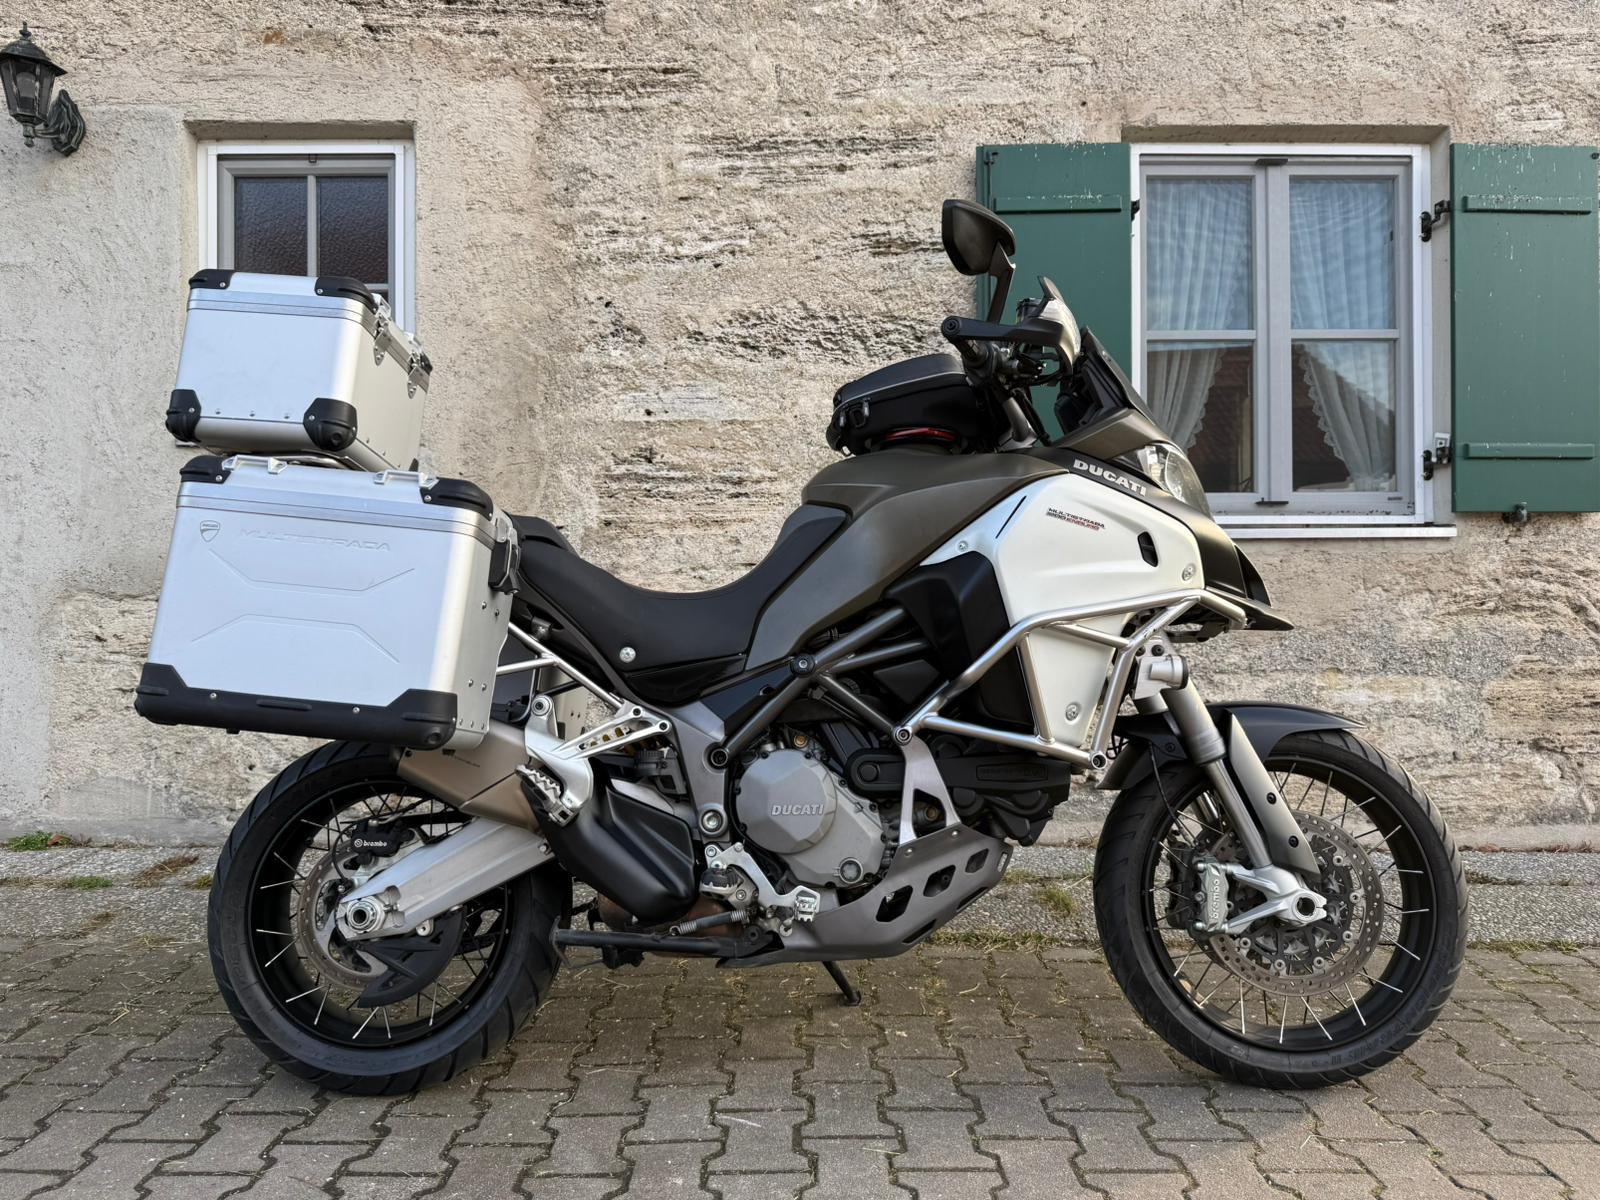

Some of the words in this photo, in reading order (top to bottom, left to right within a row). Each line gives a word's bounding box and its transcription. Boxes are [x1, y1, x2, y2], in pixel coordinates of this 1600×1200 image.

[1073, 459, 1147, 497] DUCATI
[771, 804, 824, 816] DUCATI
[1211, 879, 1220, 919] brembo
